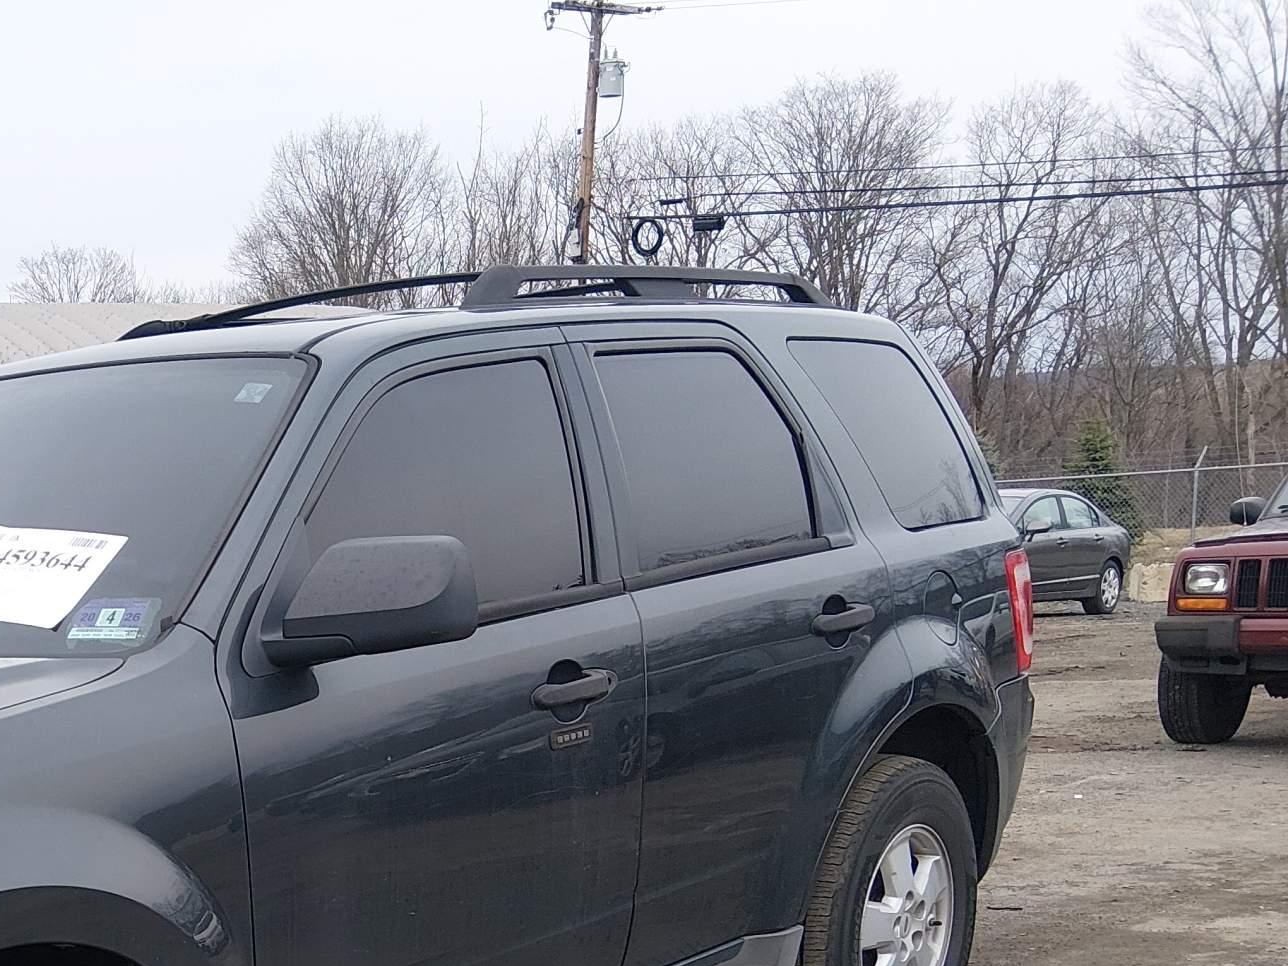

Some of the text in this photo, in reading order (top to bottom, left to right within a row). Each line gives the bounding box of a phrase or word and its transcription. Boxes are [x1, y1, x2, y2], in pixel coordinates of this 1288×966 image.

[79, 610, 142, 625] 20 4 26
